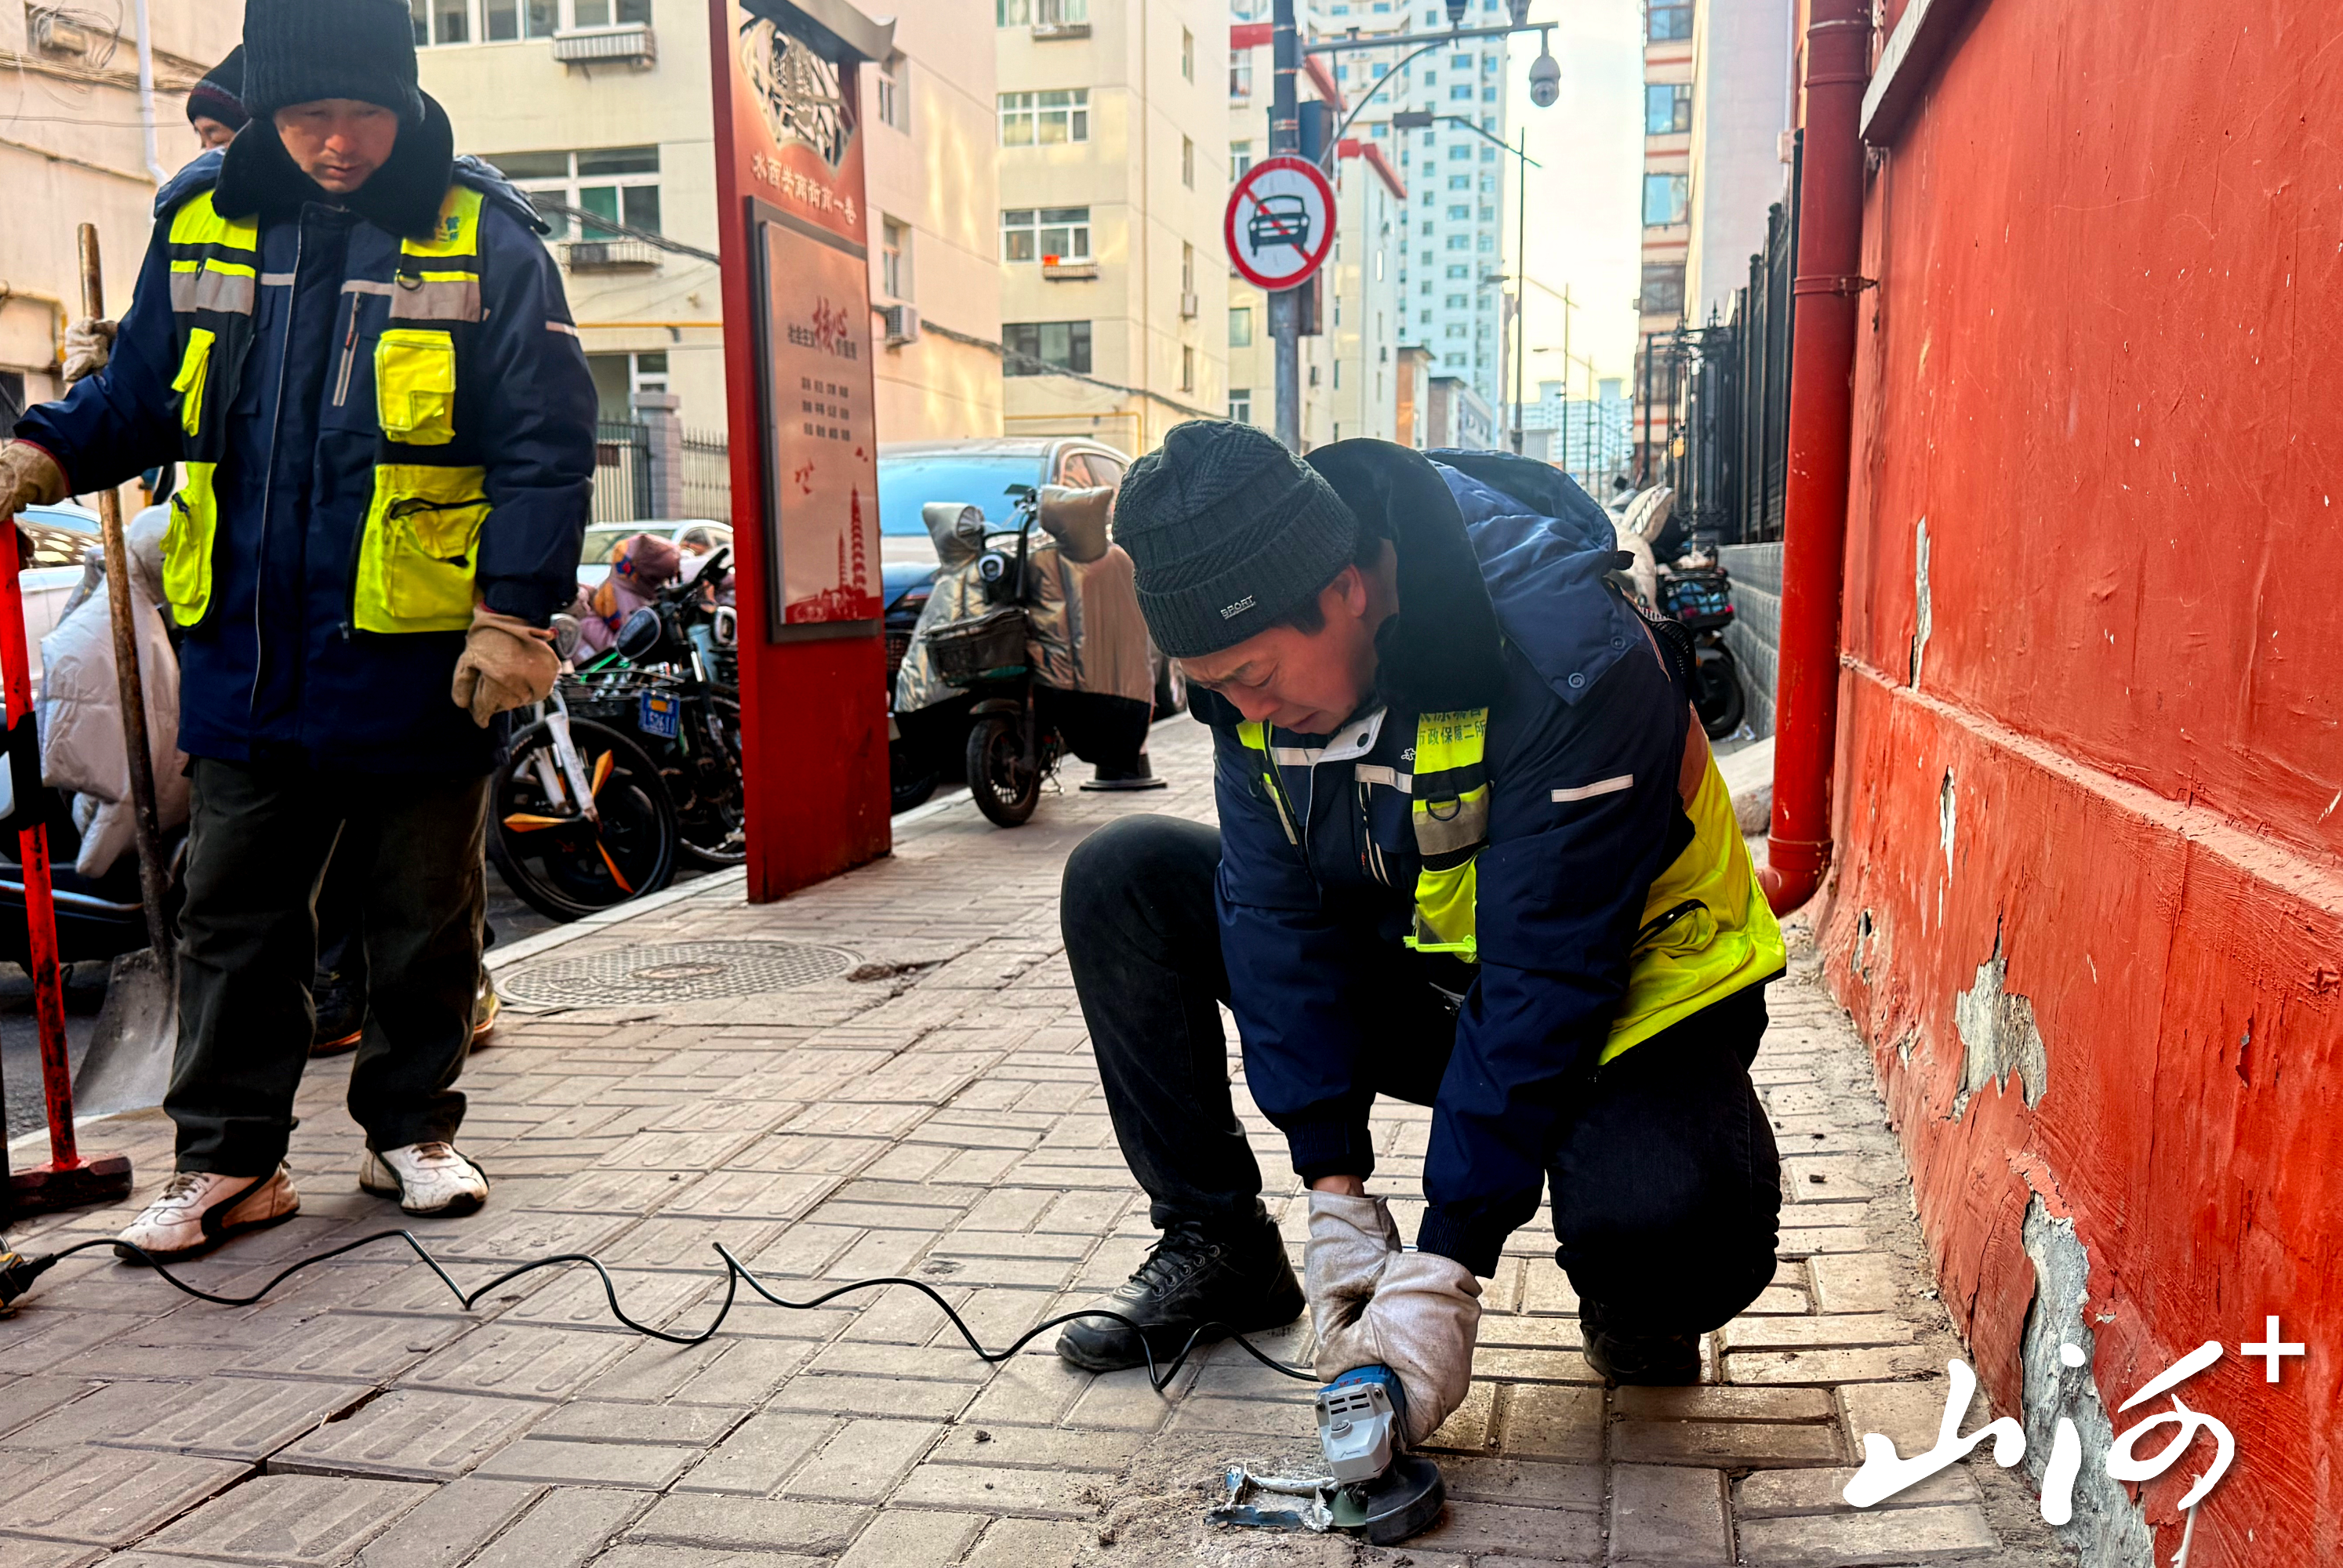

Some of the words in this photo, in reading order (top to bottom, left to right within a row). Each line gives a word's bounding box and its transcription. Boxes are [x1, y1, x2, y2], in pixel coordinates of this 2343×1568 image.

[1220, 595, 1253, 618] SPORT
[1418, 719, 1487, 746] 市政保障二所
